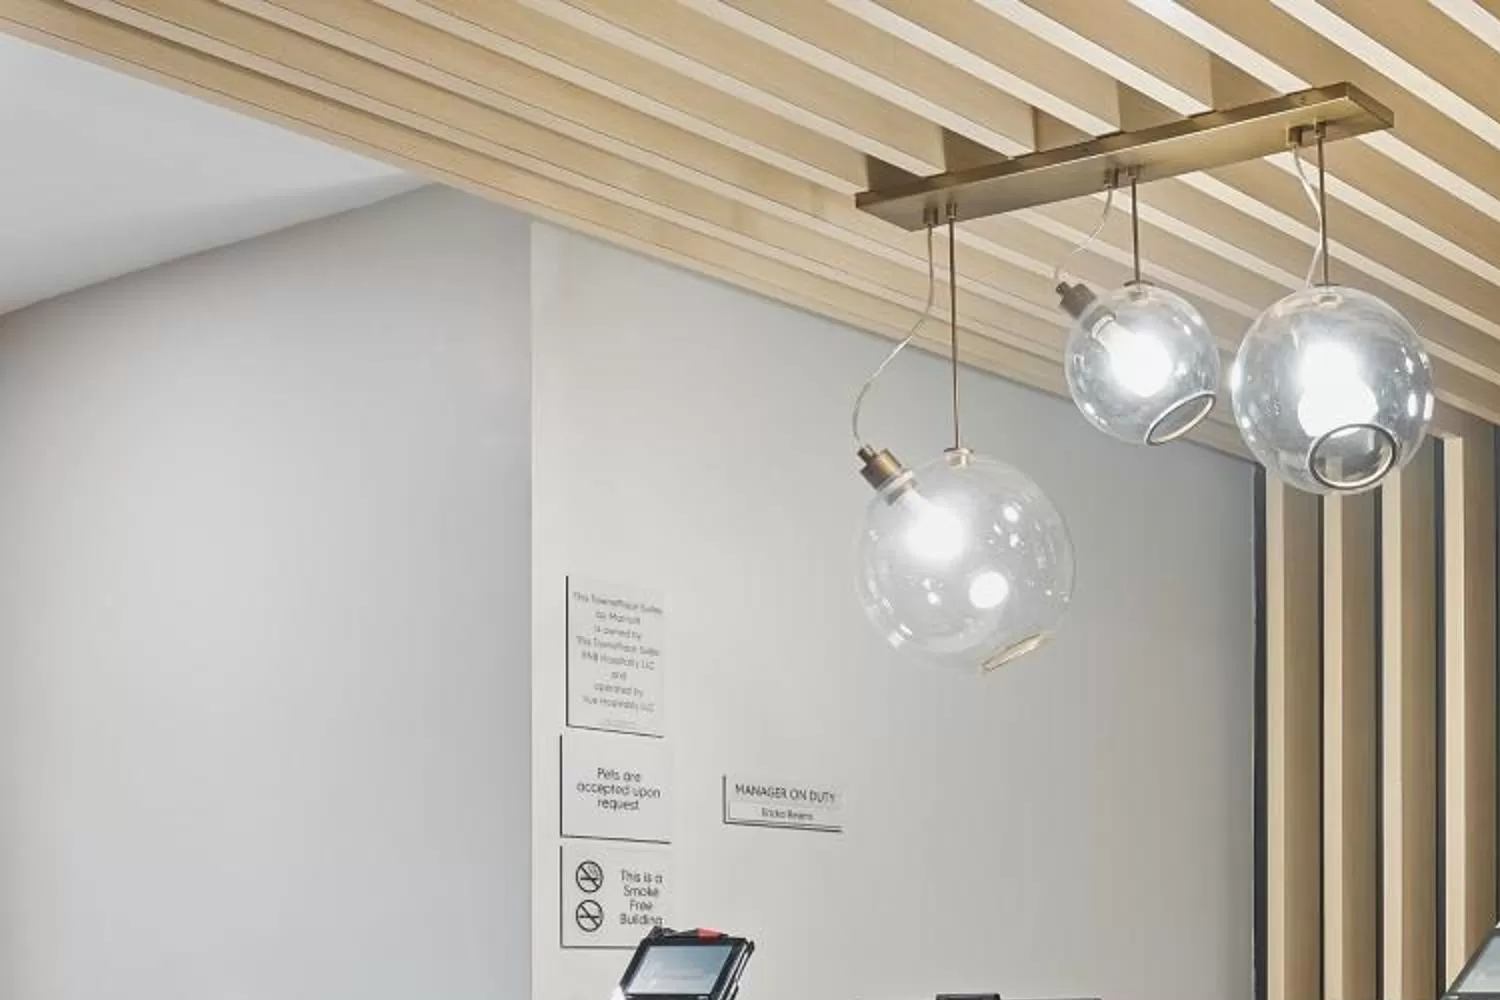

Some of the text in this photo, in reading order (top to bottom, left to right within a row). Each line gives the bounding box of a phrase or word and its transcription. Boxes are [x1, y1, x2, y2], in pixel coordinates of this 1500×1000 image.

[597, 767, 642, 783] Pets are
[576, 782, 661, 800] accepted upon
[735, 783, 835, 804] MANAGER ON DUTY
[598, 799, 639, 813] request
[620, 868, 663, 885] This is a
[622, 885, 660, 898] Smoke
[629, 899, 654, 912] Free
[620, 912, 664, 927] Building
